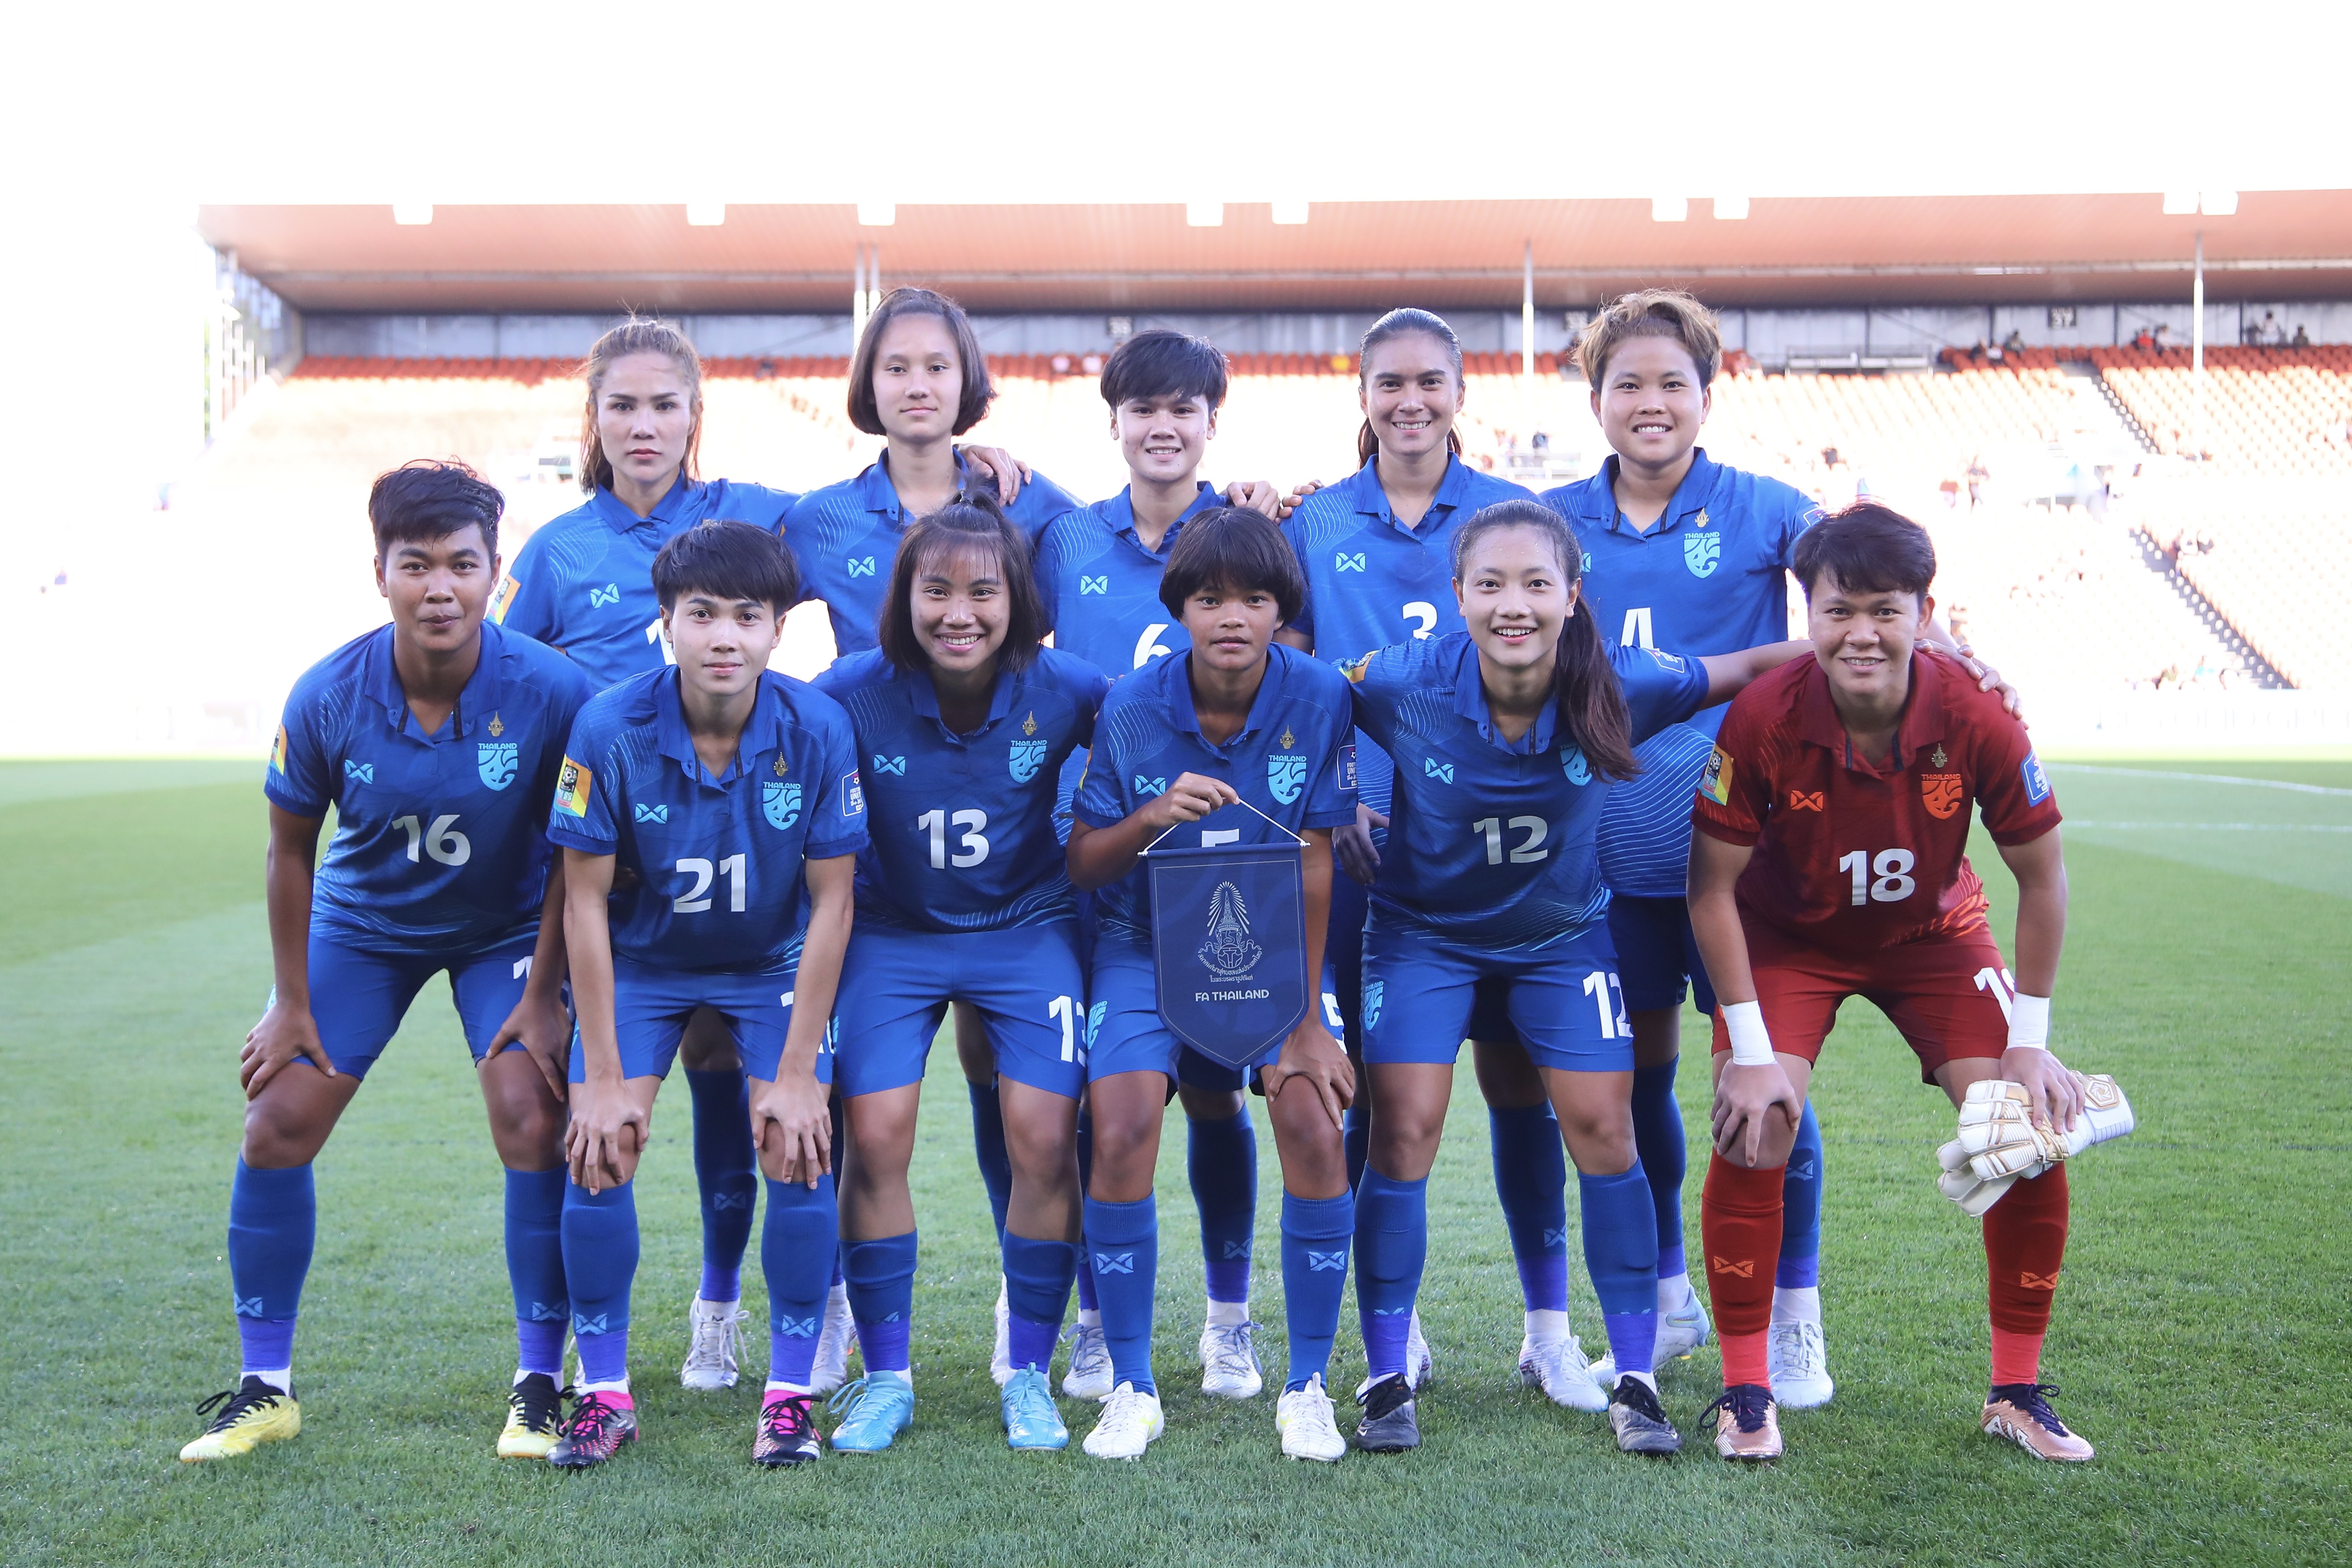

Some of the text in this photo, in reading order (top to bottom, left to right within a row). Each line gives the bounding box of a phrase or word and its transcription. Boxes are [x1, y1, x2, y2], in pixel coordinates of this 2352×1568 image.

[1402, 601, 1438, 640] 3
[1620, 607, 1661, 651] 4
[1133, 623, 1172, 670] 6
[763, 781, 801, 790] THAILAND
[392, 814, 471, 866] 16
[919, 809, 989, 869] 13
[1473, 816, 1548, 865] 12
[673, 853, 746, 913] 21
[1839, 848, 1915, 906] 18
[1195, 989, 1270, 1002] FA THAILAND
[1973, 967, 2015, 1027] 1
